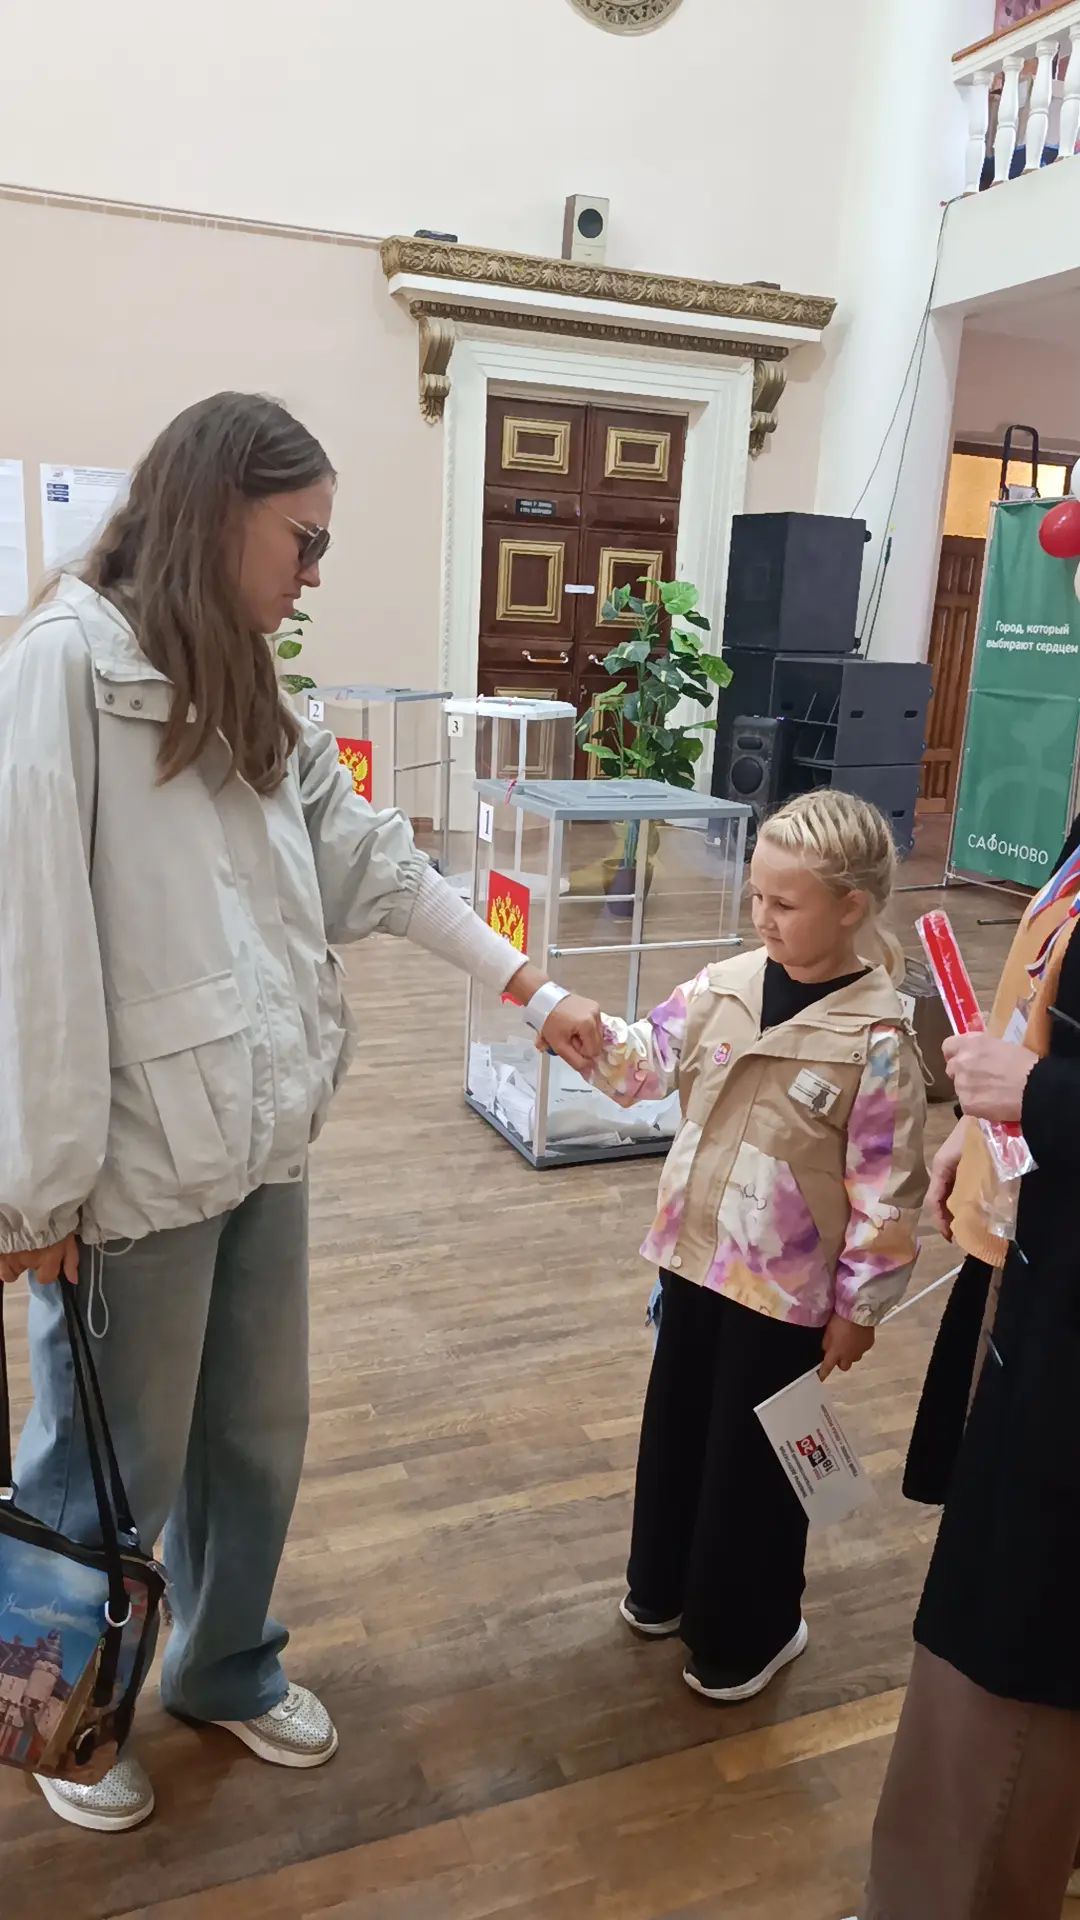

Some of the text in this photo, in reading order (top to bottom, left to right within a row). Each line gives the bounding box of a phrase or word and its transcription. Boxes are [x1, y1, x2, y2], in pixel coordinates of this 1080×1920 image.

[1026, 623, 1070, 637] который
[986, 637, 1079, 654] выбирают сердцем
[312, 702, 320, 718] 2
[452, 720, 459, 734] 3
[484, 809, 490, 836] 1
[968, 833, 1049, 865] САФОНОВО
[800, 1438, 814, 1455] 20
[812, 1450, 824, 1465] 19
[822, 1459, 834, 1472] 18
